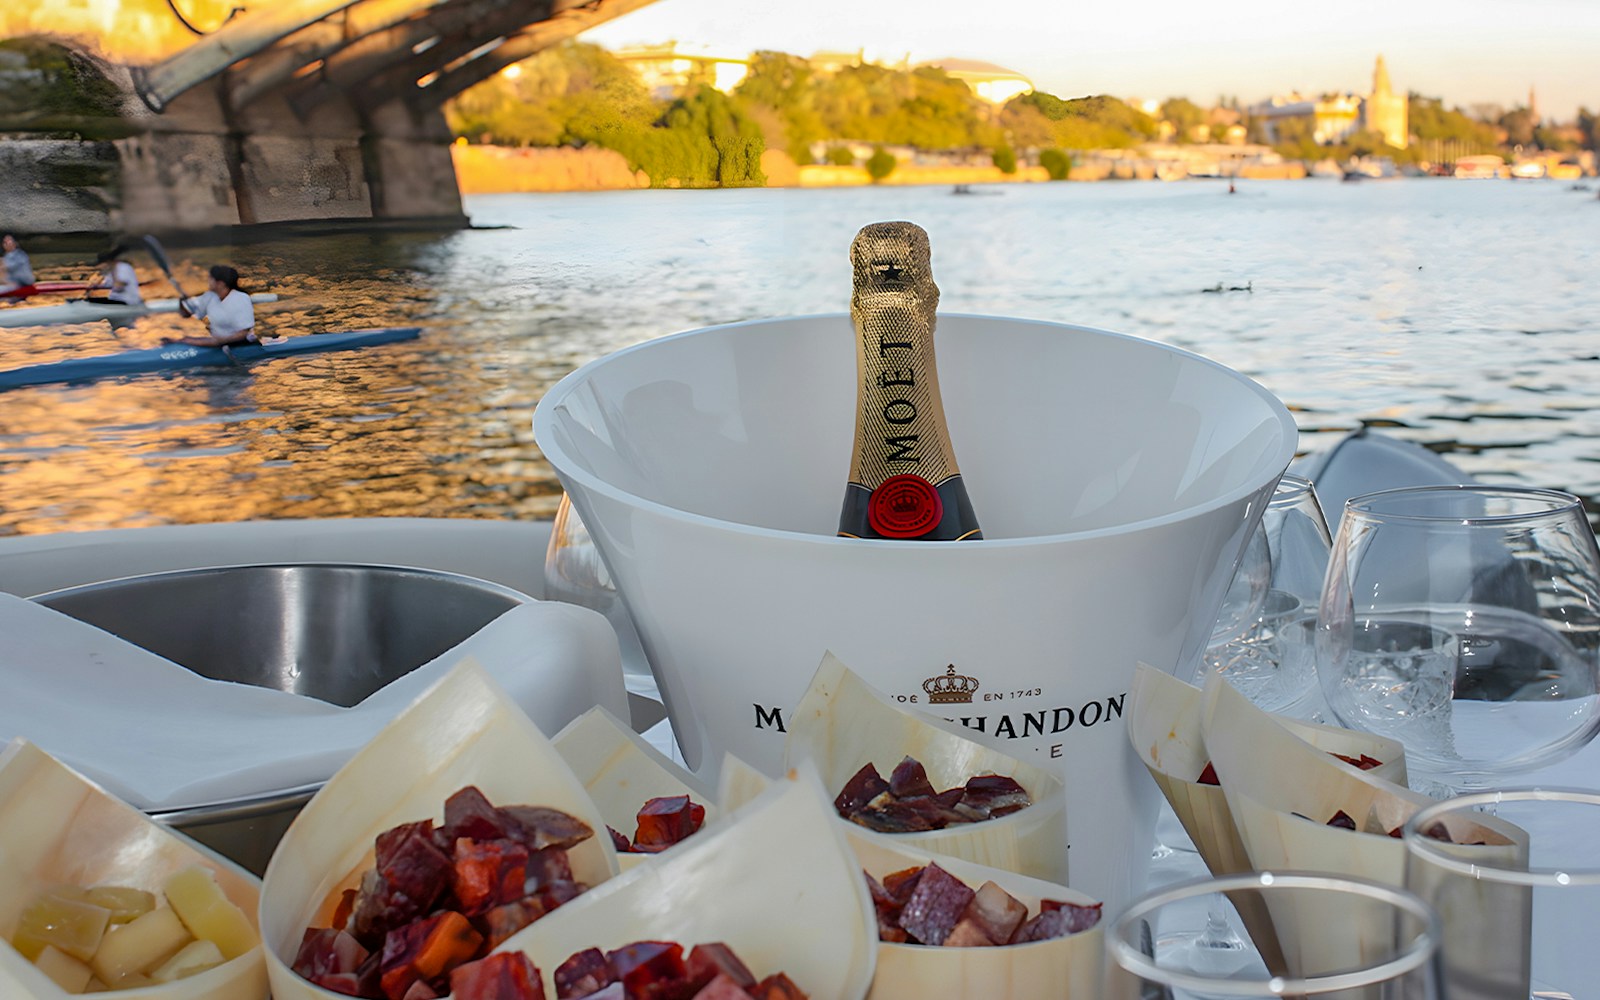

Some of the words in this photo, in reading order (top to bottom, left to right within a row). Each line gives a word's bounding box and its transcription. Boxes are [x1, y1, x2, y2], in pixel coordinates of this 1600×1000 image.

[983, 692, 1004, 701] EN
[1010, 688, 1042, 699] 1743
[943, 693, 1127, 740] HANDON
